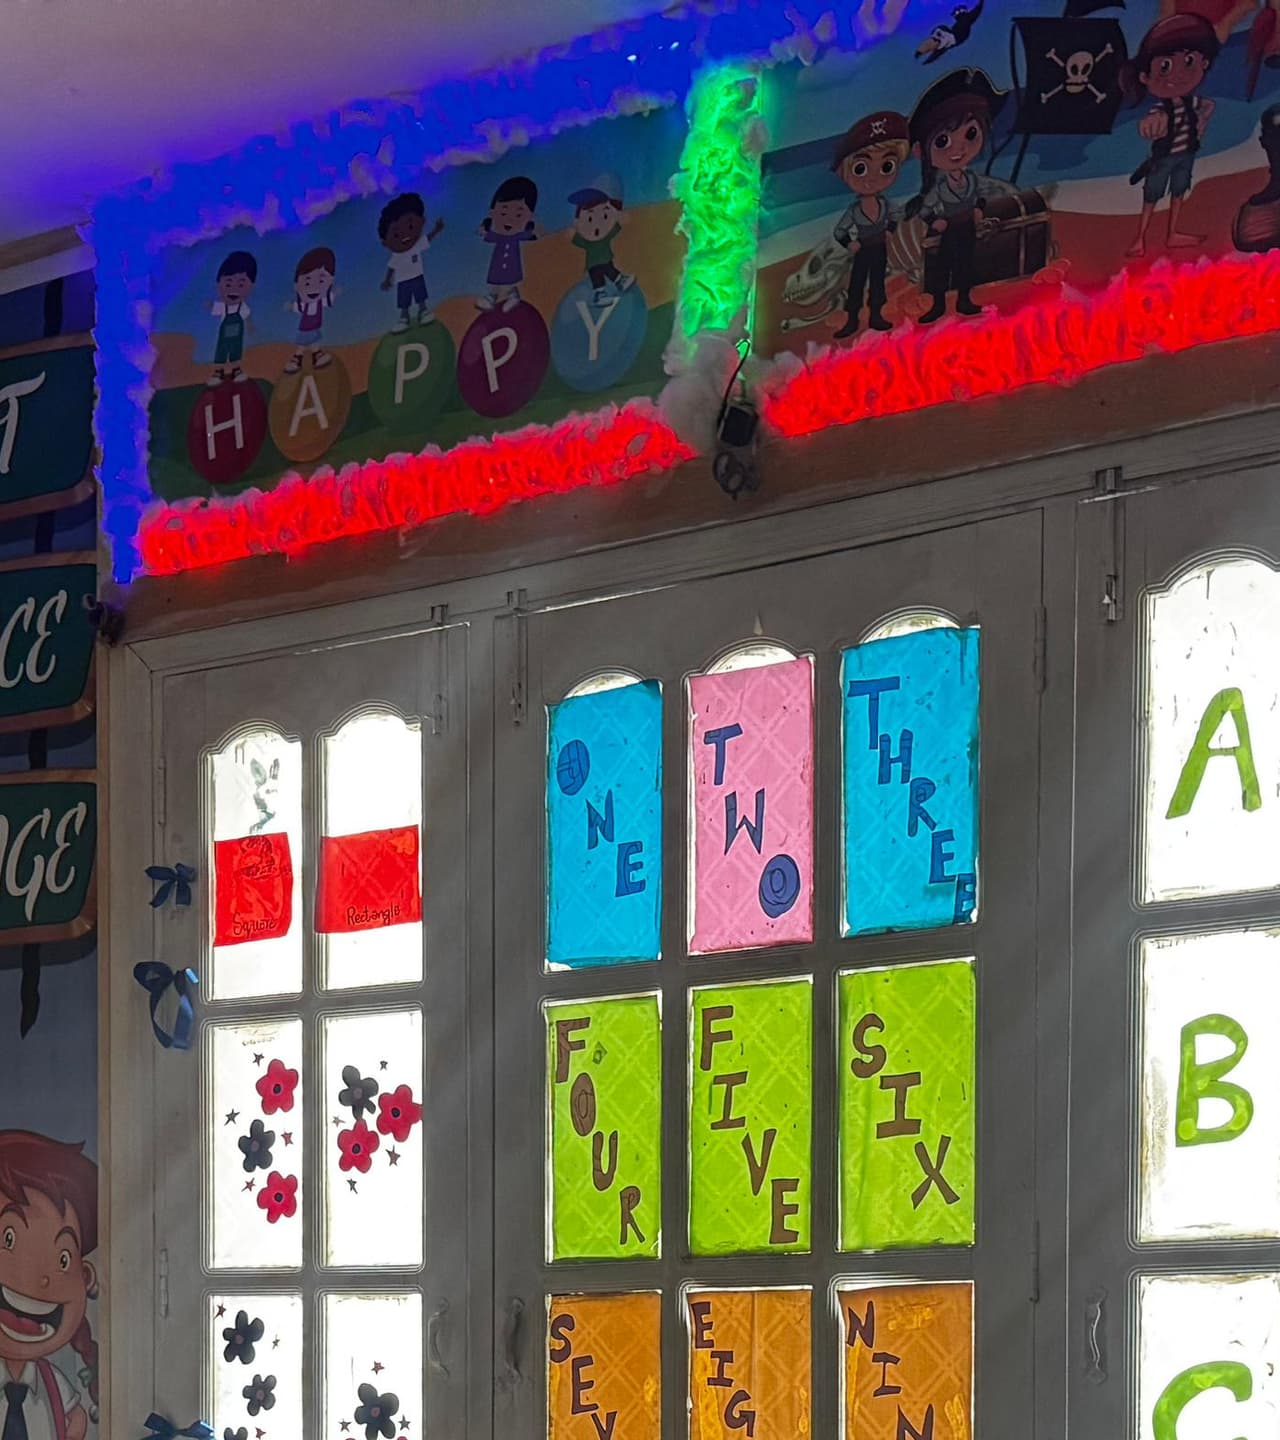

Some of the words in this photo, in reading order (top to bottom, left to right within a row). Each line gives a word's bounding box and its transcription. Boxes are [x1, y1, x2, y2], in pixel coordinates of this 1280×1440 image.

[205, 296, 620, 459] HAPPY
[556, 738, 646, 898] ONE
[704, 722, 800, 919] TWO
[848, 676, 976, 925] THREE
[1165, 687, 1261, 819] A
[233, 912, 277, 937] Square
[346, 902, 400, 926] Rectangle
[555, 1017, 646, 1245] FOUR
[699, 1005, 799, 1245] FIVE
[851, 1013, 959, 1210] SIX
[1176, 1013, 1254, 1146] B
